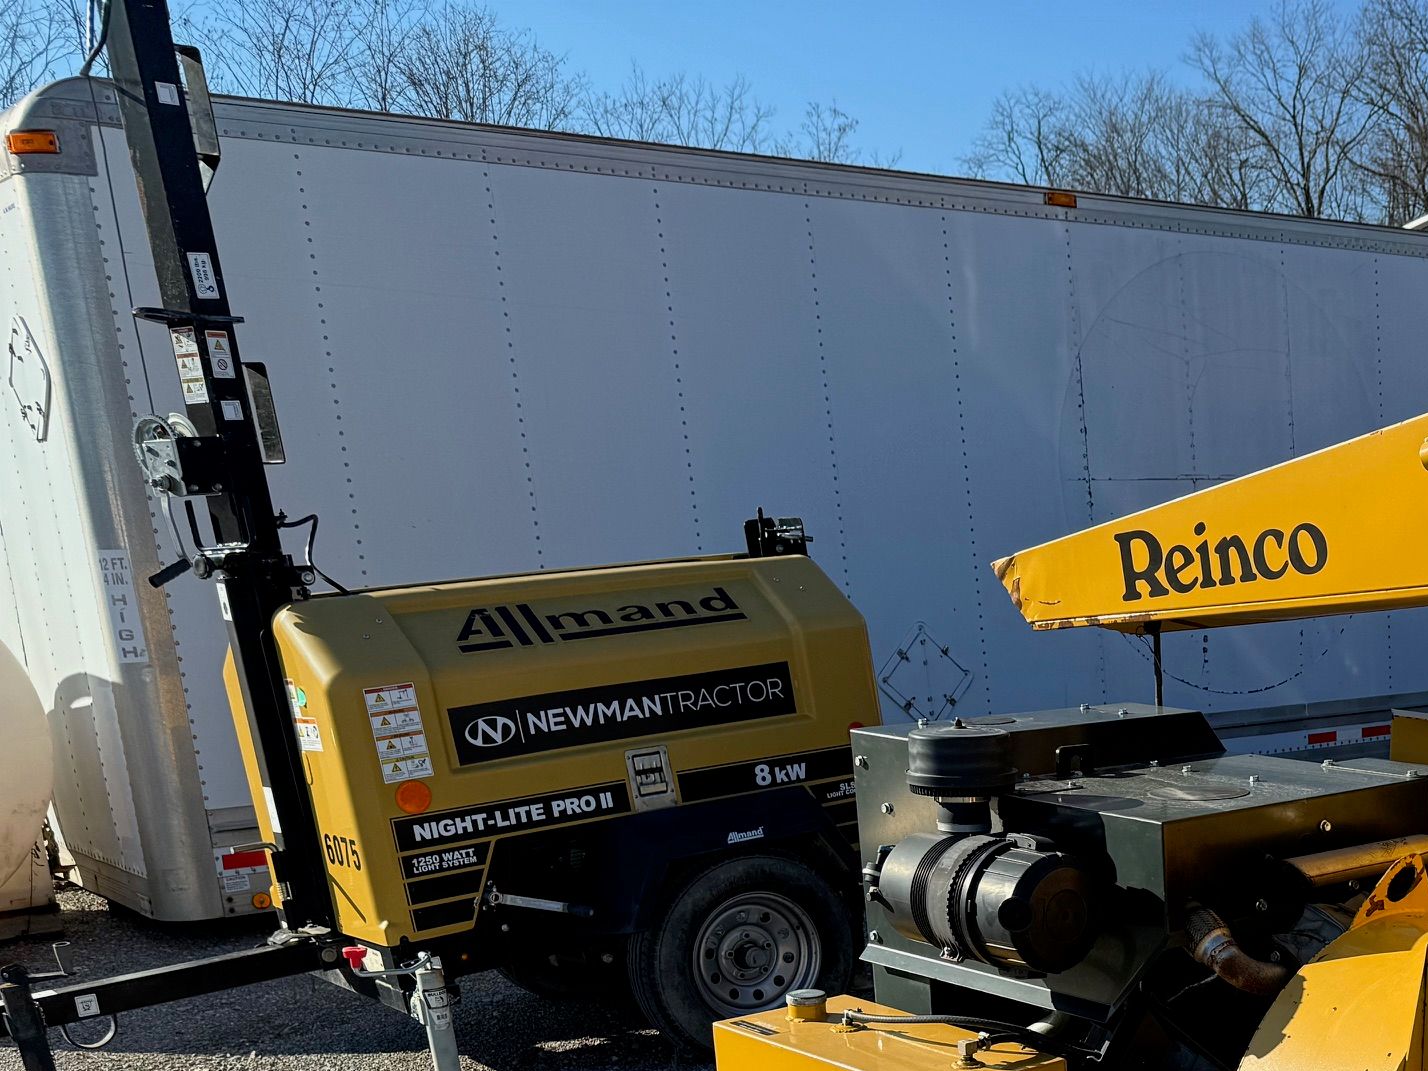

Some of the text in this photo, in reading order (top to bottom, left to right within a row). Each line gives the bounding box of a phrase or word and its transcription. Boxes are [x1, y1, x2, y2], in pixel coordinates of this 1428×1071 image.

[98, 557, 110, 571] 12
[1114, 521, 1328, 602] Reinco
[103, 573, 110, 586] 4
[456, 587, 746, 652] Allmand
[754, 762, 806, 786] 8 kW
[412, 803, 546, 841] NIGHT-LITE
[551, 795, 596, 817] PRO
[727, 826, 764, 844] Allmand
[324, 833, 362, 871] 6075
[412, 847, 475, 867] 1250 WATT
[413, 855, 477, 874] LIGHT SYSTEM
